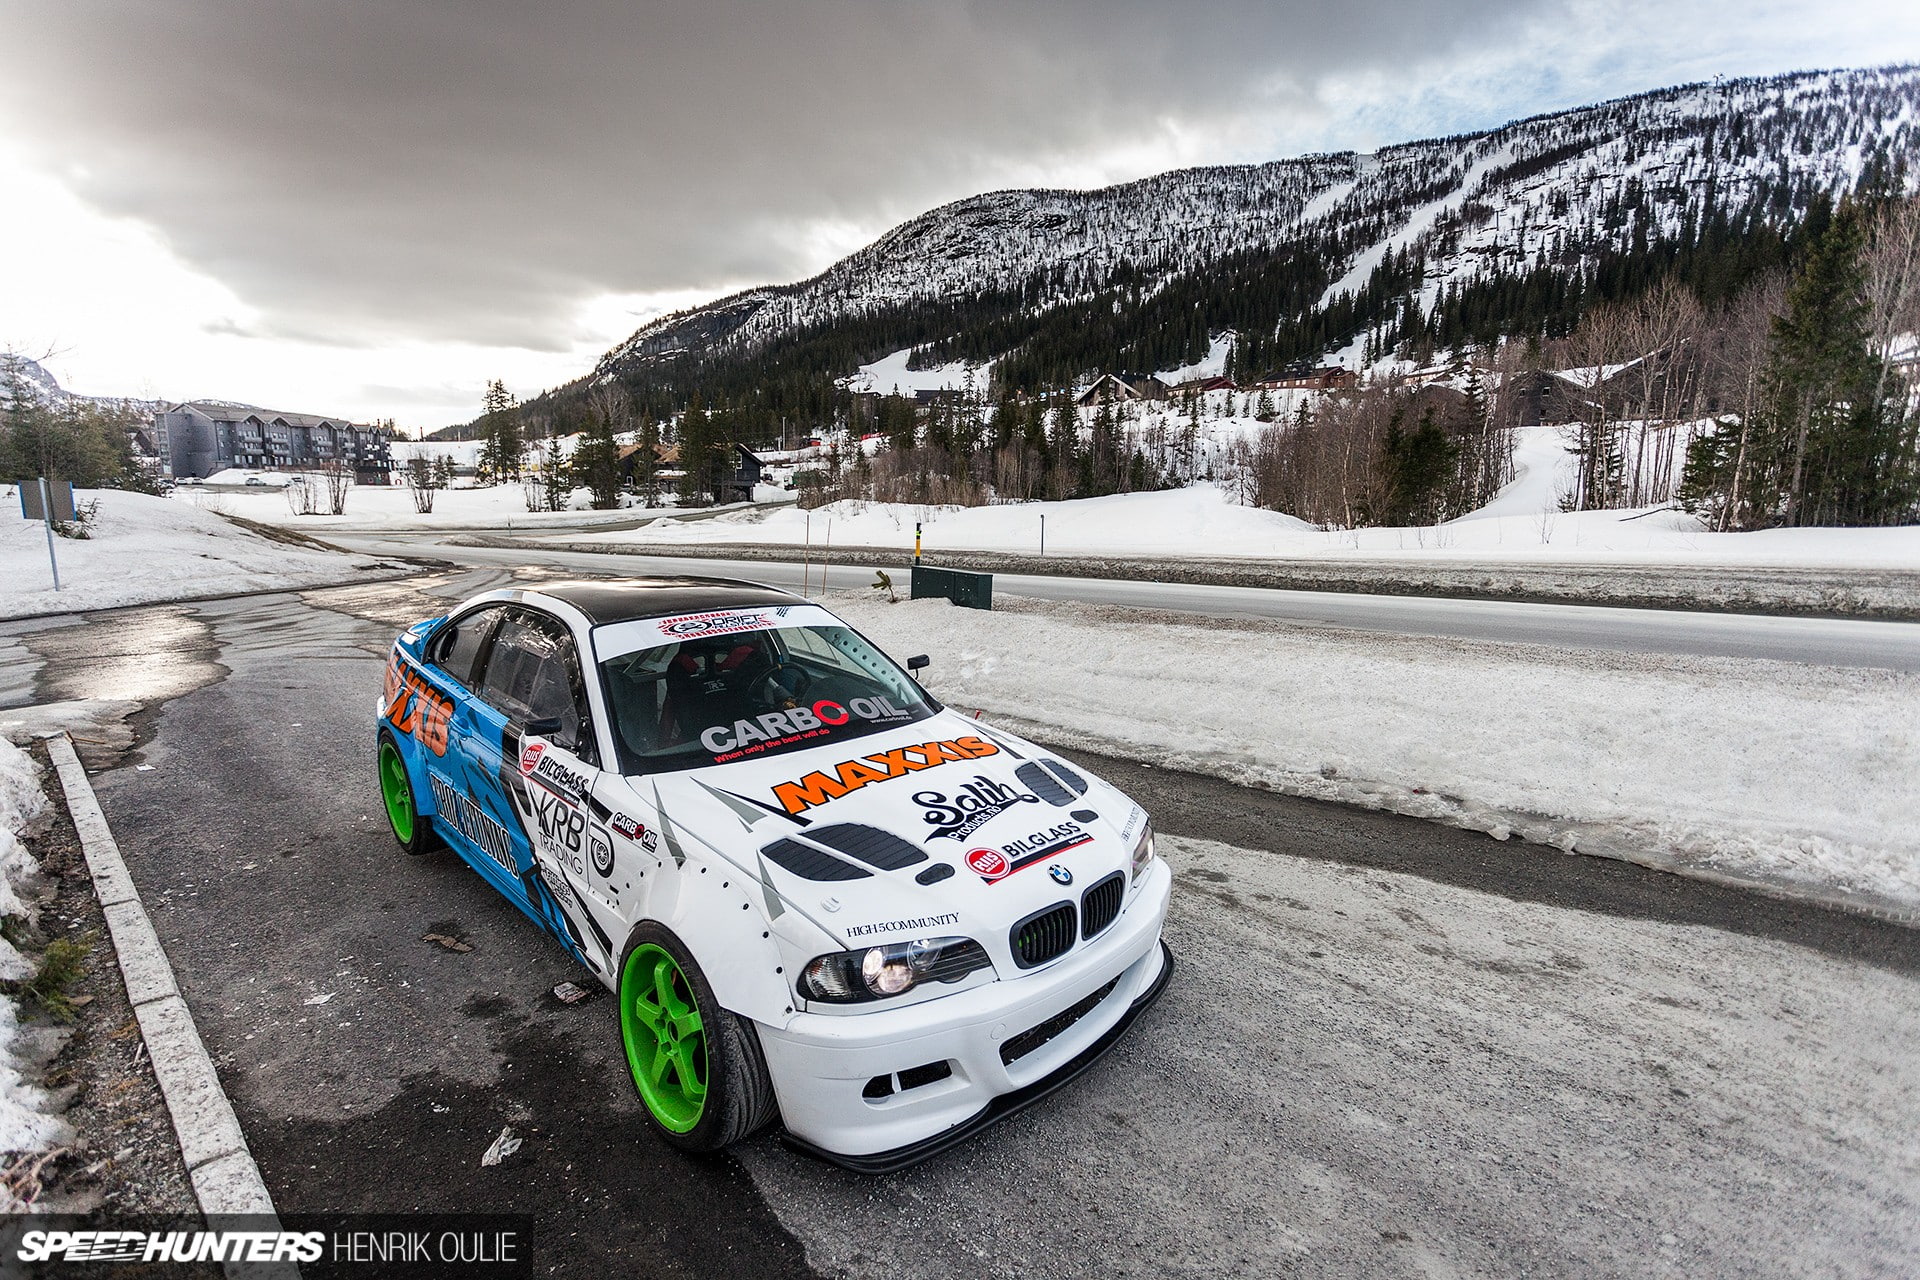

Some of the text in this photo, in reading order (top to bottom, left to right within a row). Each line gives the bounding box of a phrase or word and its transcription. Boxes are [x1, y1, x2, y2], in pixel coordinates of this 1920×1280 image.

[711, 613, 762, 627] DRIFT
[850, 697, 909, 719] OIL
[714, 750, 744, 763] When
[745, 744, 765, 754] only
[765, 740, 782, 748] the
[782, 735, 802, 744] best
[802, 731, 818, 739] will
[538, 755, 589, 796] BILGLASS
[771, 736, 1000, 816] MAXXIS
[539, 791, 585, 853] KRB
[642, 829, 658, 848] OIL
[538, 830, 583, 875] TRADING
[1001, 821, 1081, 858] BILGLASS
[972, 851, 999, 871] RIIS
